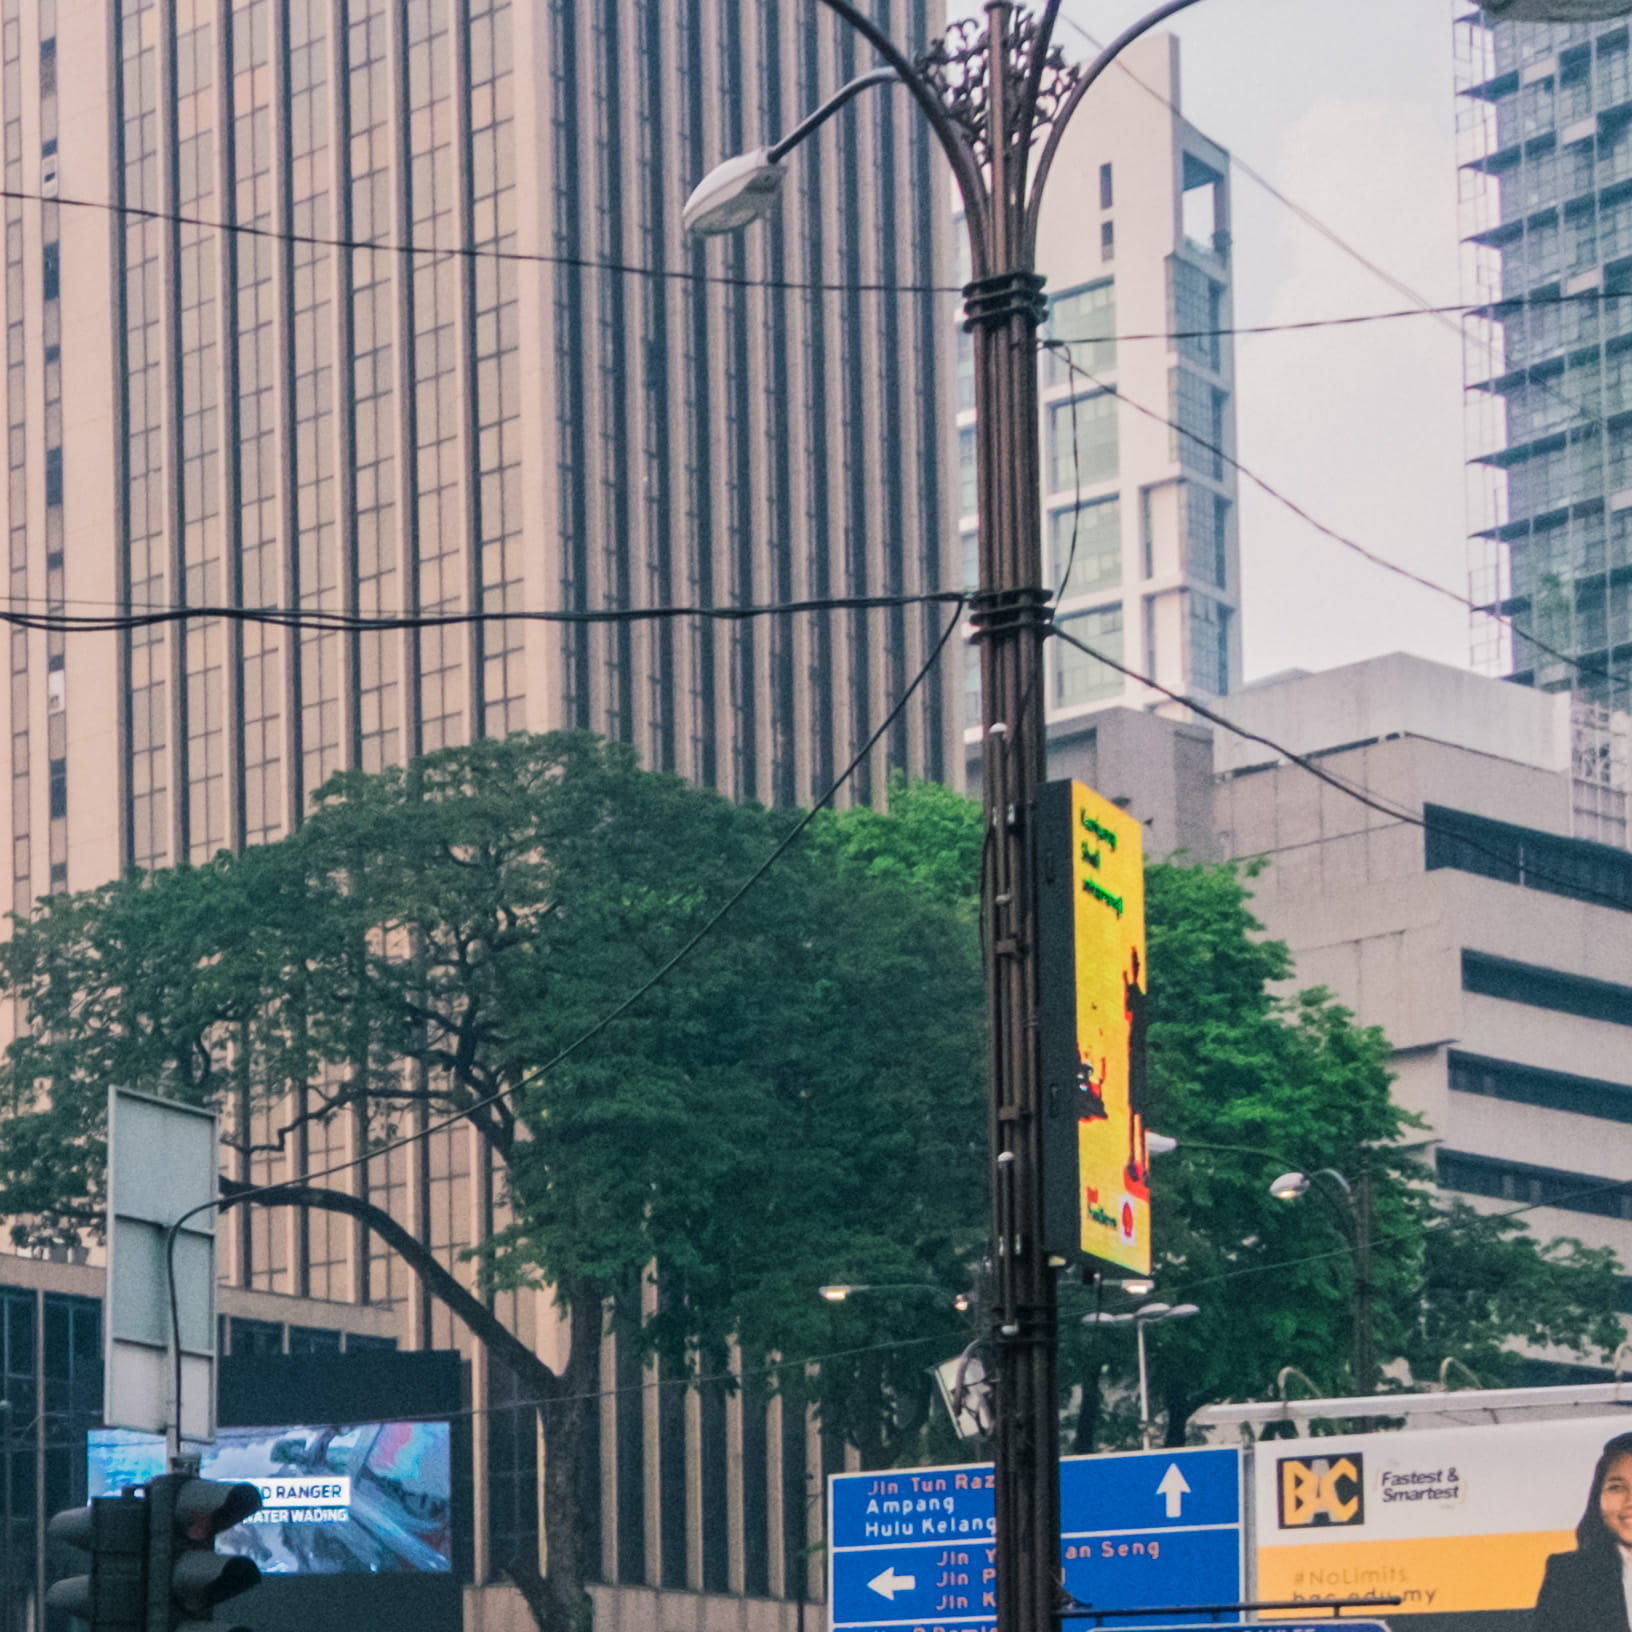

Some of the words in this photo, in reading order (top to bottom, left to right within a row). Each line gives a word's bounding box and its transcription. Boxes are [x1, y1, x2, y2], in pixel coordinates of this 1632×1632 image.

[868, 1480, 898, 1496] Jln
[911, 1476, 946, 1493] Tun
[955, 1474, 996, 1490] Raz
[1382, 1469, 1442, 1486] Fastest
[1447, 1467, 1459, 1482] &
[276, 1485, 342, 1499] RANGER
[1383, 1485, 1459, 1503] Smartest
[866, 1496, 955, 1515] Ampang
[290, 1508, 348, 1523] WADING
[865, 1521, 914, 1538] Hulu
[922, 1517, 997, 1536] Kelang
[937, 1551, 969, 1566] Jln
[1065, 1544, 1092, 1560] an
[1101, 1540, 1160, 1560] Seng
[937, 1571, 969, 1587] Jln
[1293, 1566, 1407, 1586] #NoLimits
[937, 1595, 969, 1610] Jln
[1292, 1588, 1437, 1604] bacedumy
